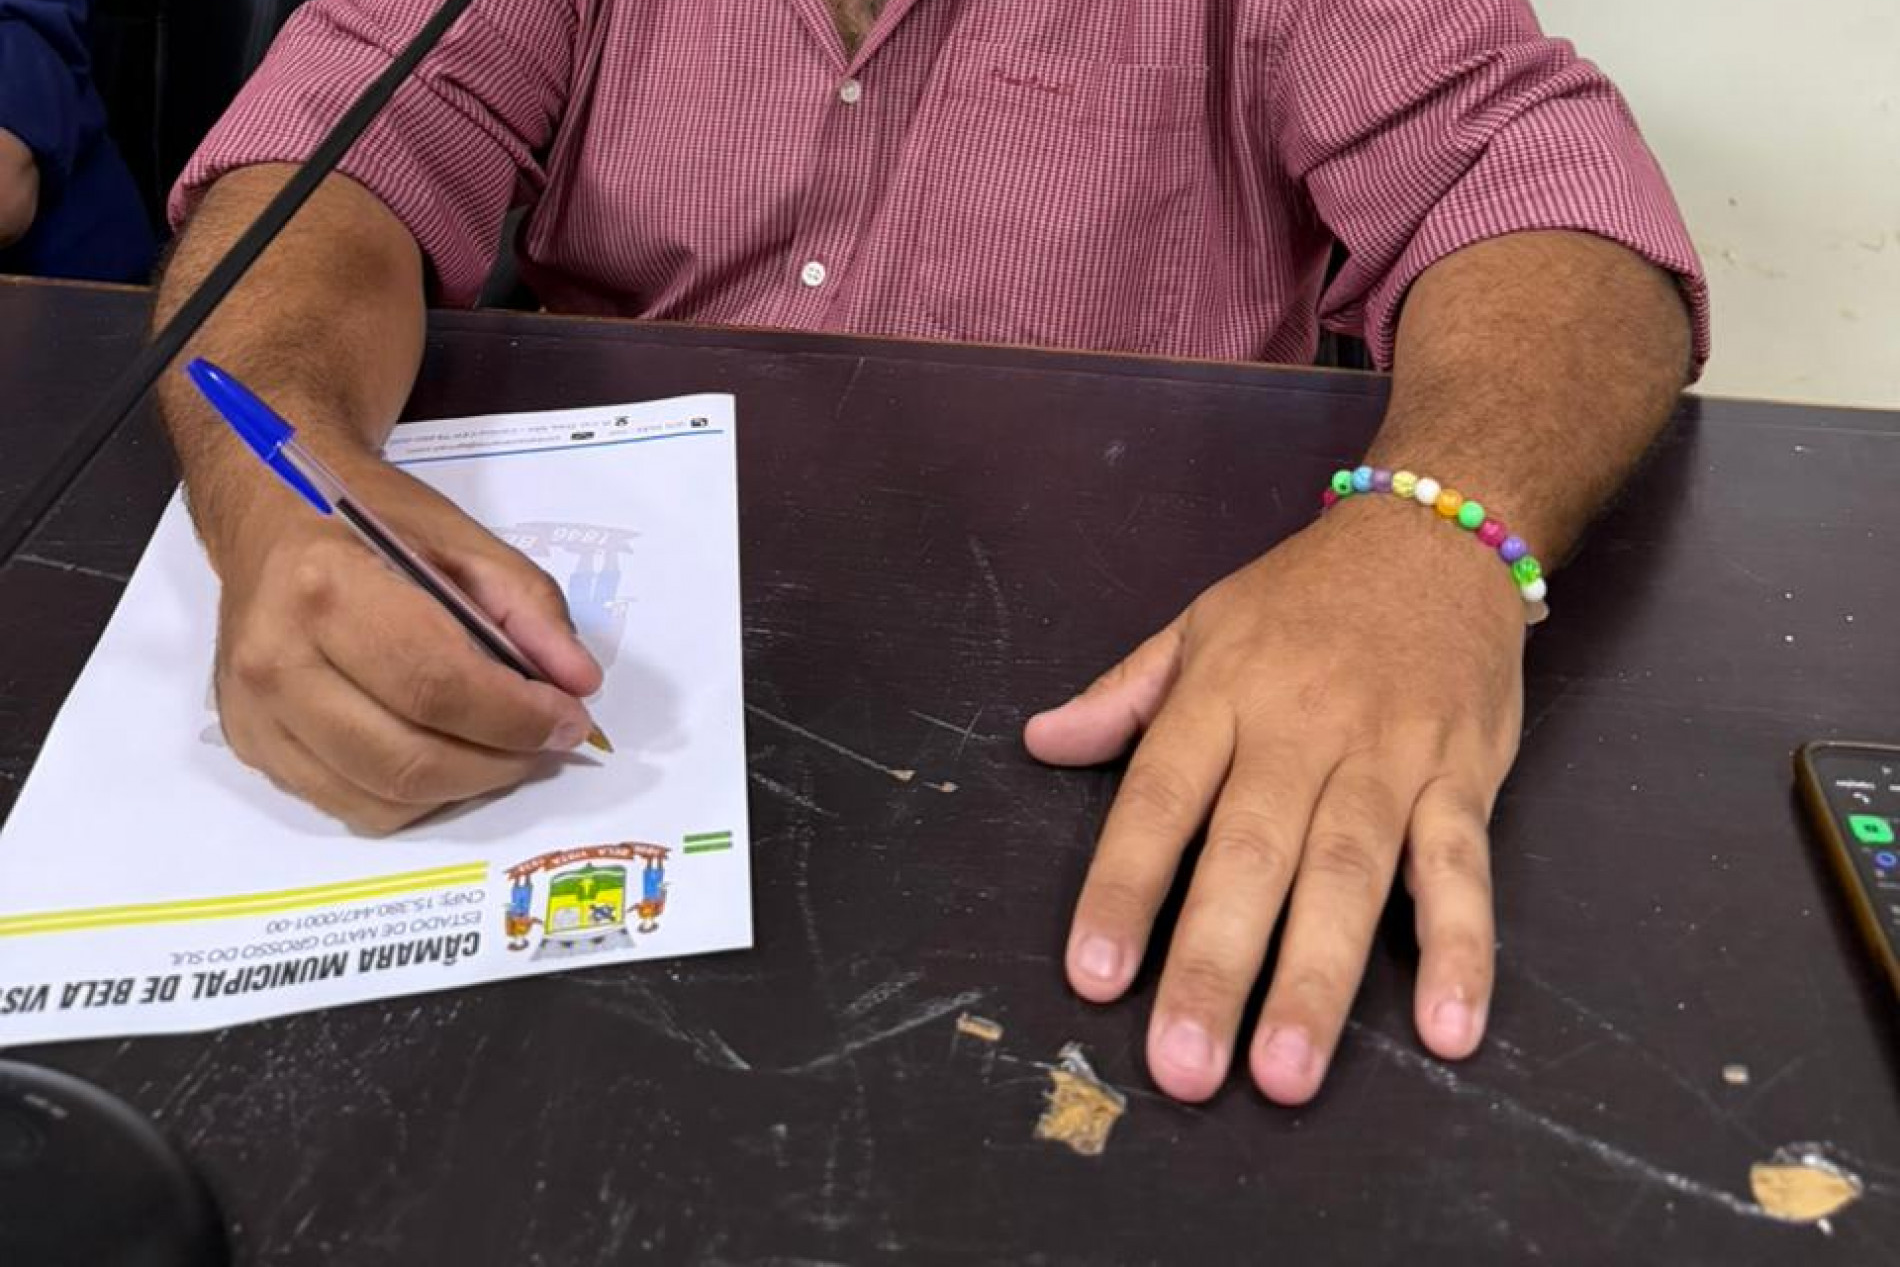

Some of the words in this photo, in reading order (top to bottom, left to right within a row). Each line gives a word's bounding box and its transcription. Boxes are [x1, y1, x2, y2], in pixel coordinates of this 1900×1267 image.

[382, 921, 406, 936] DE
[410, 911, 482, 932] ESTADO
[241, 936, 320, 959] GROSSO
[323, 926, 378, 946] MATO
[170, 950, 204, 966] SUL
[208, 947, 238, 963] DO
[358, 931, 480, 973] CÂMARA
[192, 951, 349, 1000] MUNICIPAL
[0, 984, 51, 1015] VIS
[59, 978, 135, 1010] BELA
[139, 974, 182, 1005] DE
